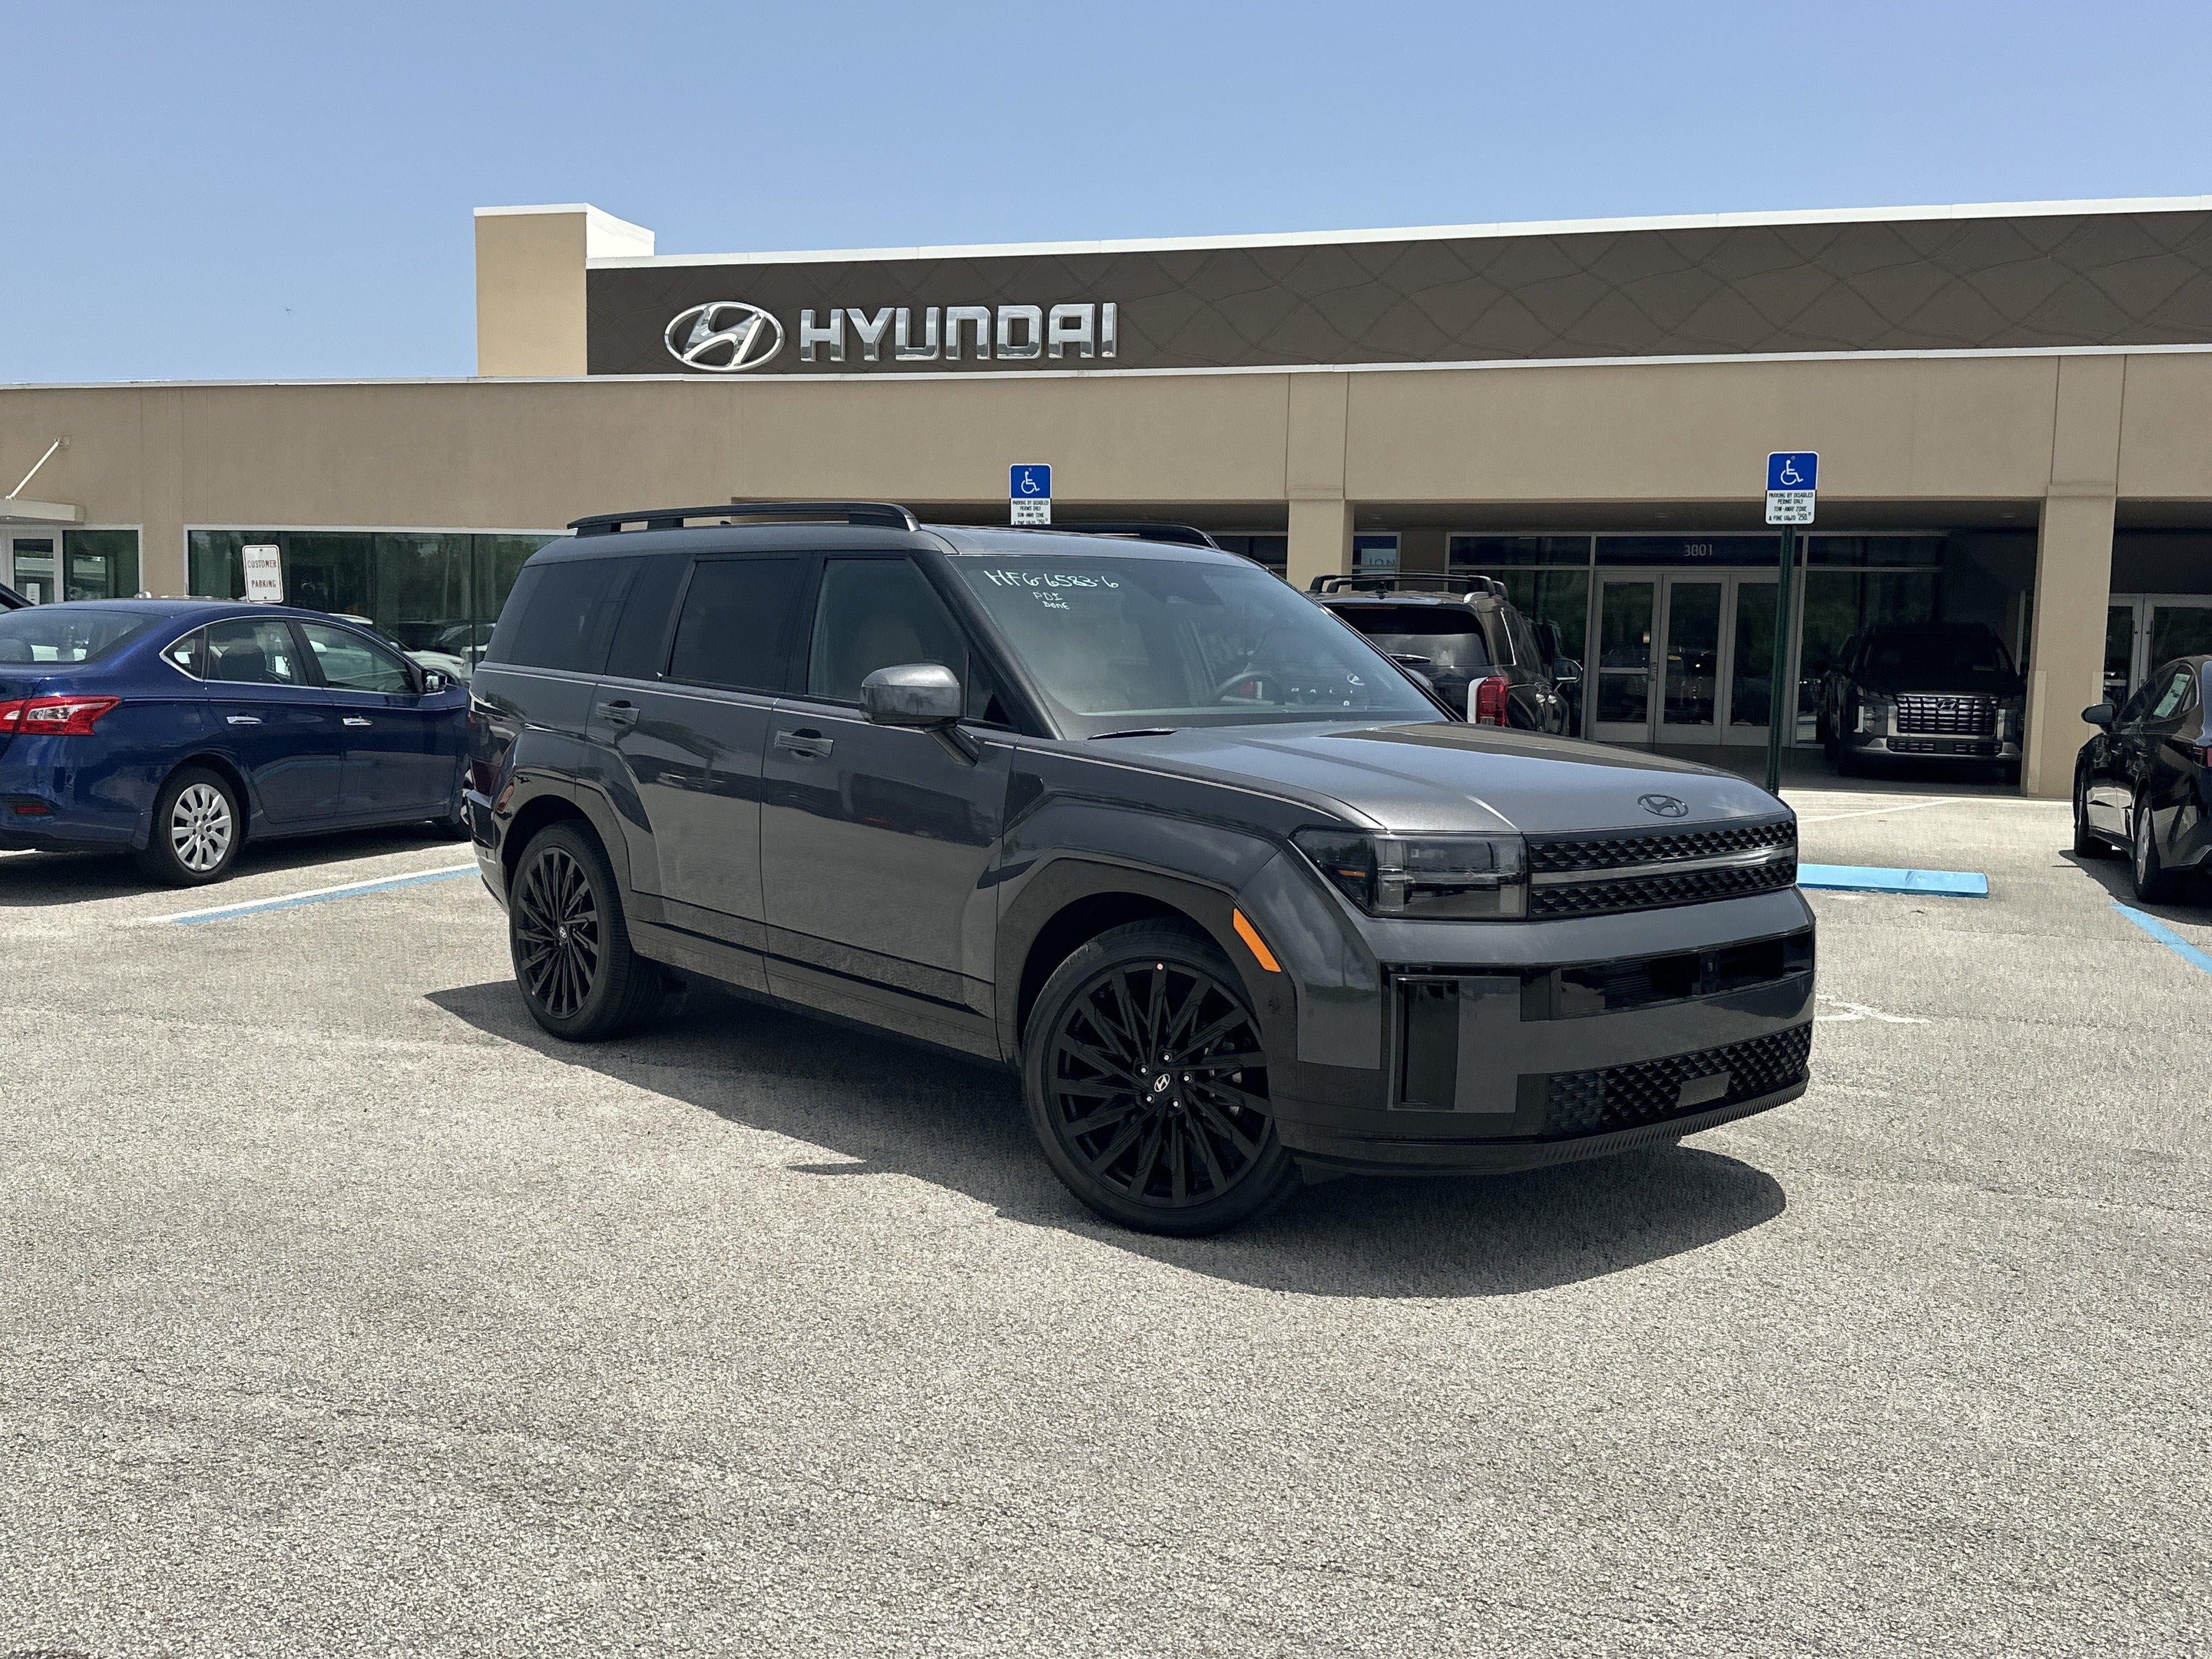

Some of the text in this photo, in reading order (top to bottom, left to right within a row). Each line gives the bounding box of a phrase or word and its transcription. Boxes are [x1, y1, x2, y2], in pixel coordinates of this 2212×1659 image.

[800, 303, 1117, 362] HYUNDAI
[247, 560, 277, 568] CUSTOMER
[251, 580, 276, 588] PARKING
